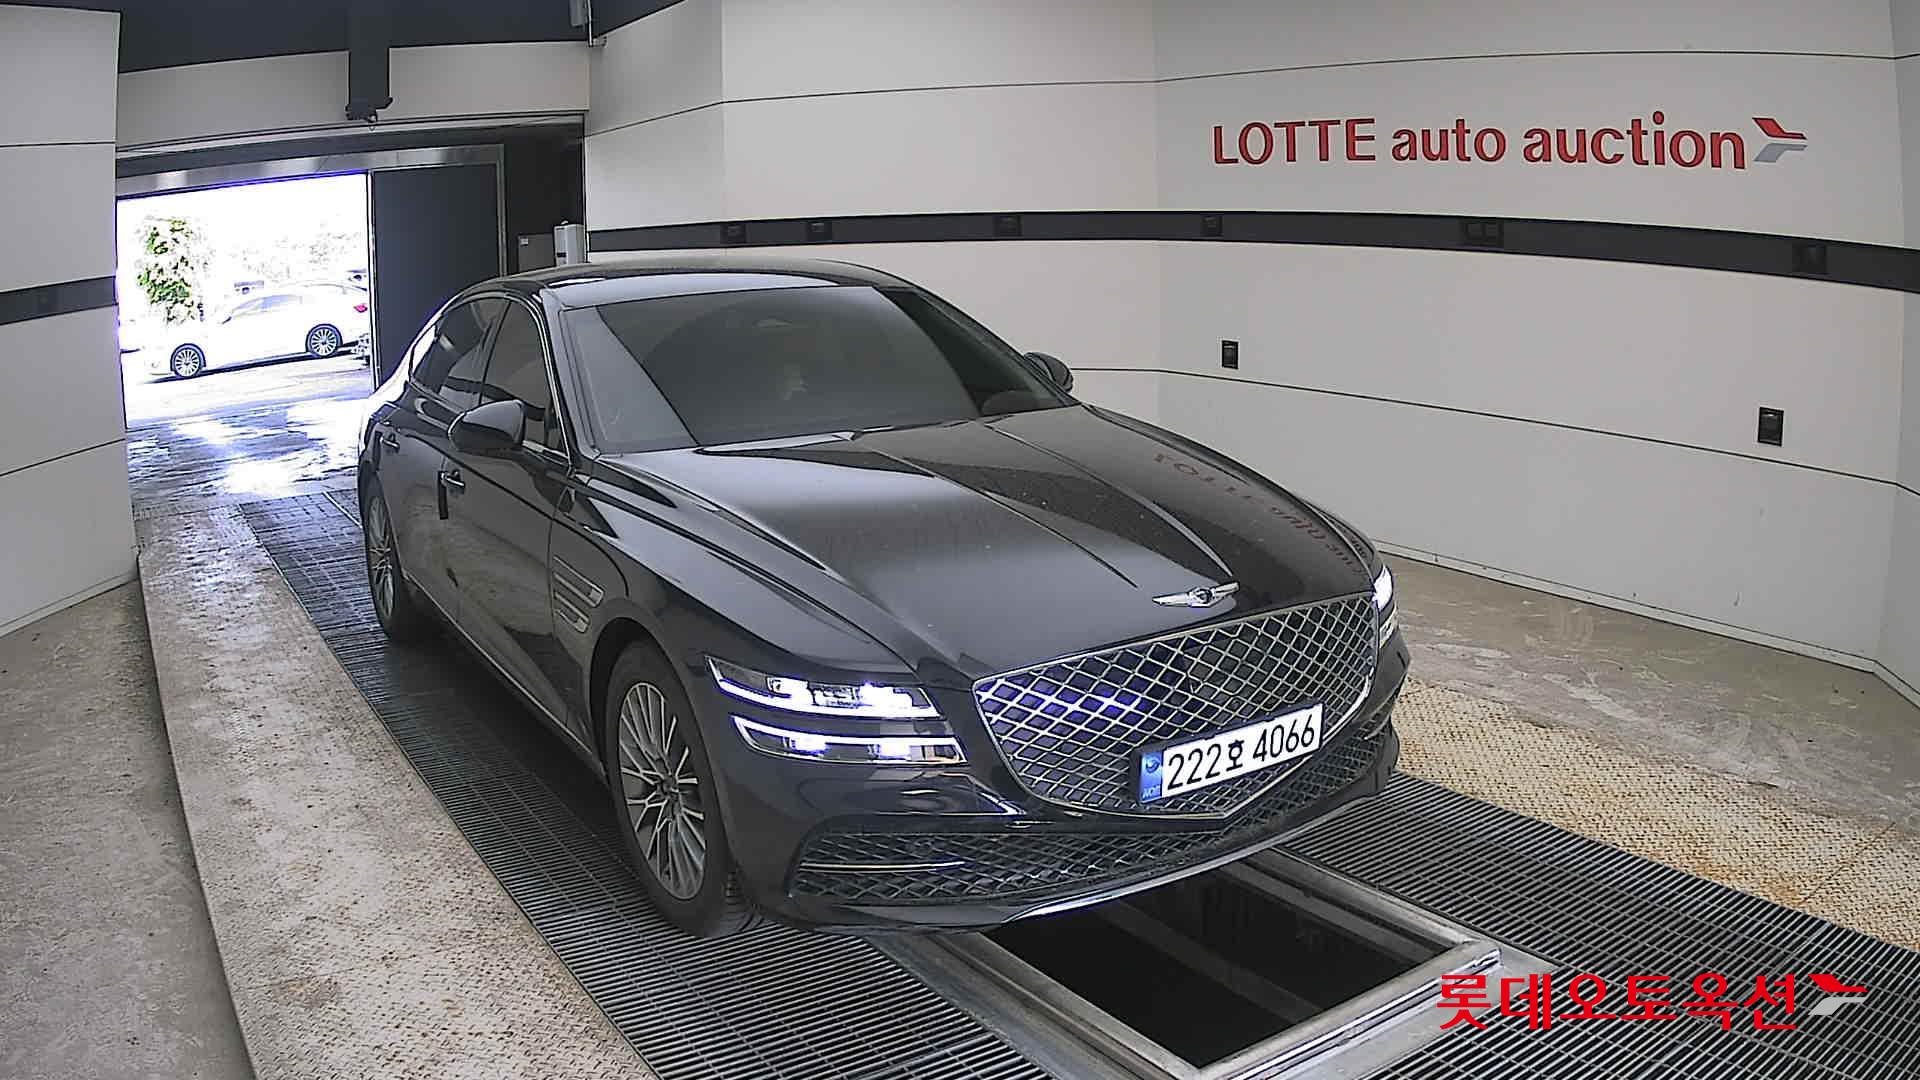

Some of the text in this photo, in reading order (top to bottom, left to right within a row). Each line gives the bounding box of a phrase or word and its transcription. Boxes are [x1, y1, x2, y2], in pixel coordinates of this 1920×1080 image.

[1213, 111, 1746, 169] LOTTE auto auction
[1166, 713, 1315, 791] 222호 4066
